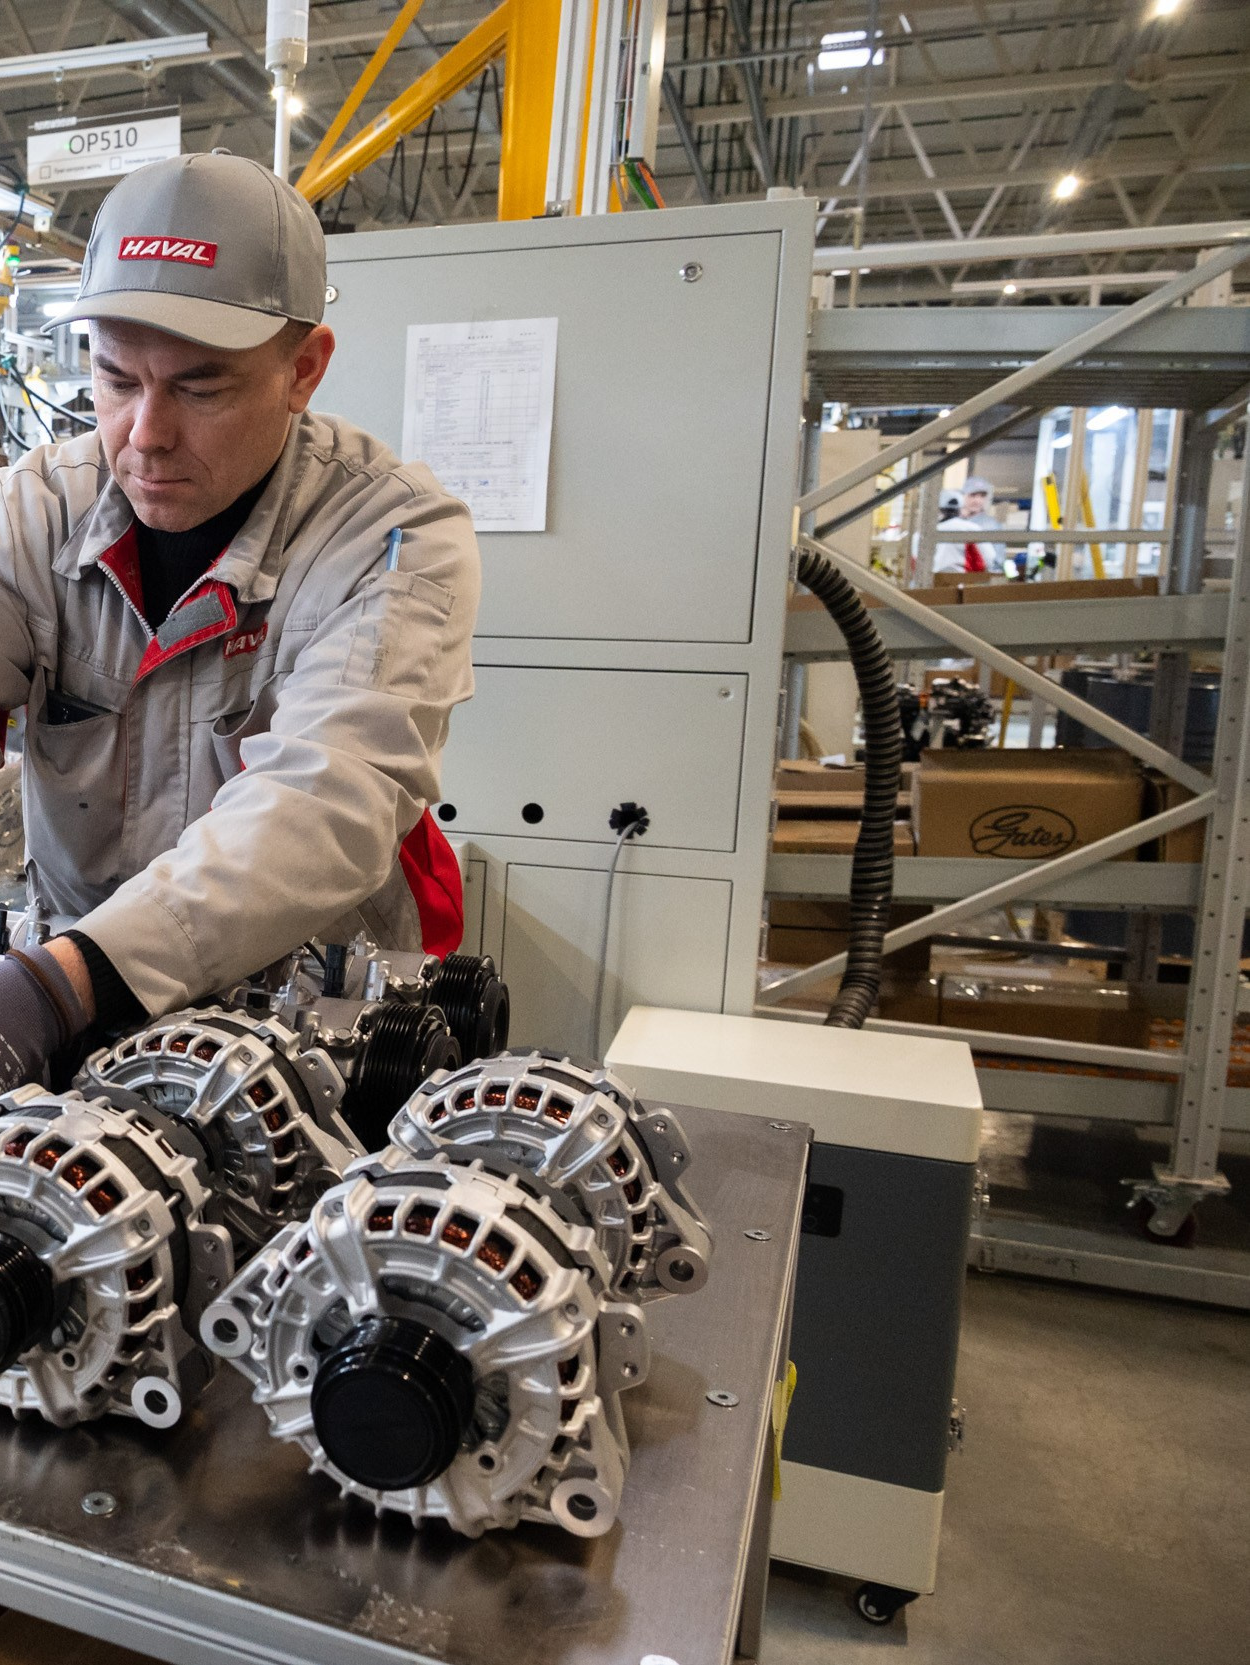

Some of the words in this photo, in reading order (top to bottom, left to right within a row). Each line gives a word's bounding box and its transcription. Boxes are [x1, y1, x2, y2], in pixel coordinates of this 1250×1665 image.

[68, 127, 138, 154] OP510
[121, 239, 210, 261] HAVAL
[973, 811, 1071, 855] Gates
